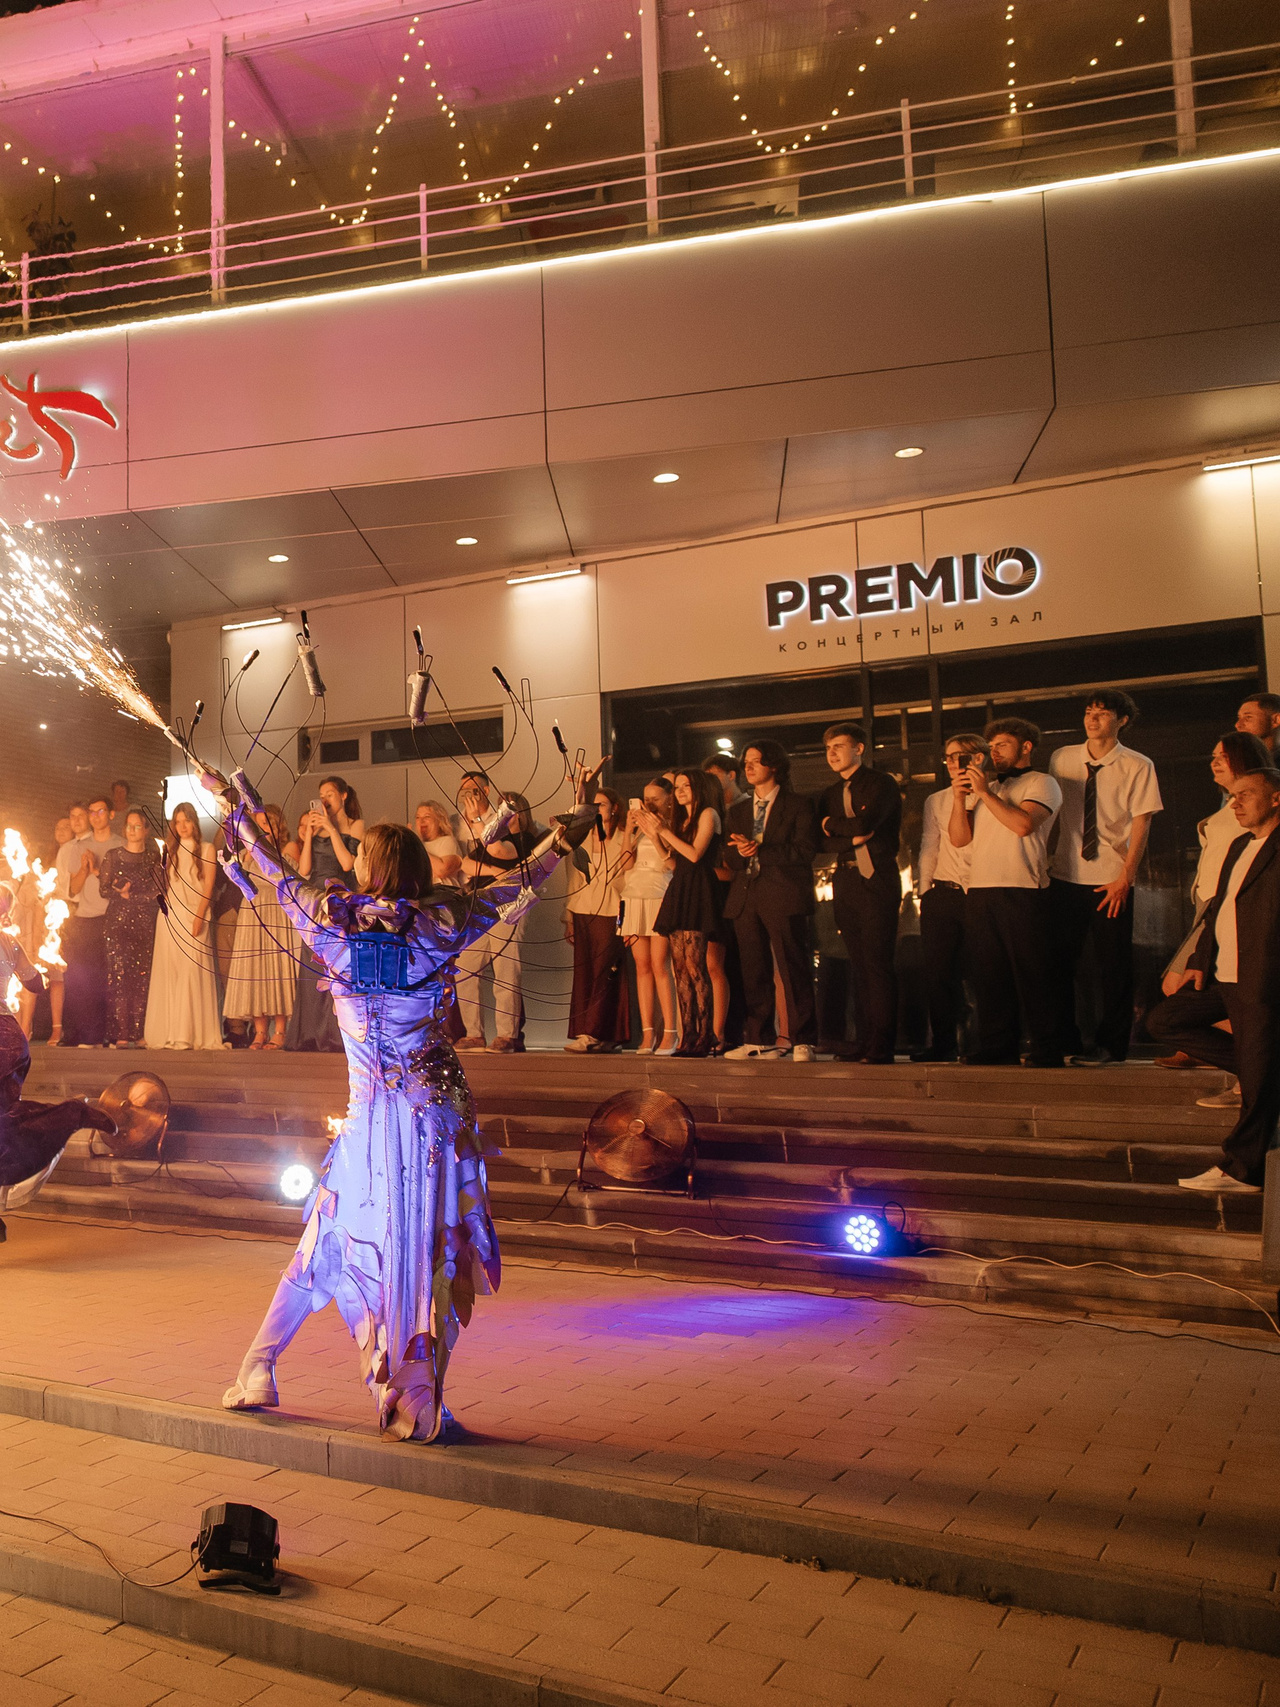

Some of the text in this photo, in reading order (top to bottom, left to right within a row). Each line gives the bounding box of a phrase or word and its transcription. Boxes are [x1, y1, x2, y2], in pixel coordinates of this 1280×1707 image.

[765, 547, 1039, 627] PREMIO
[778, 611, 1043, 652] КОНЦЕРТНЫЙ ЗАЛ
